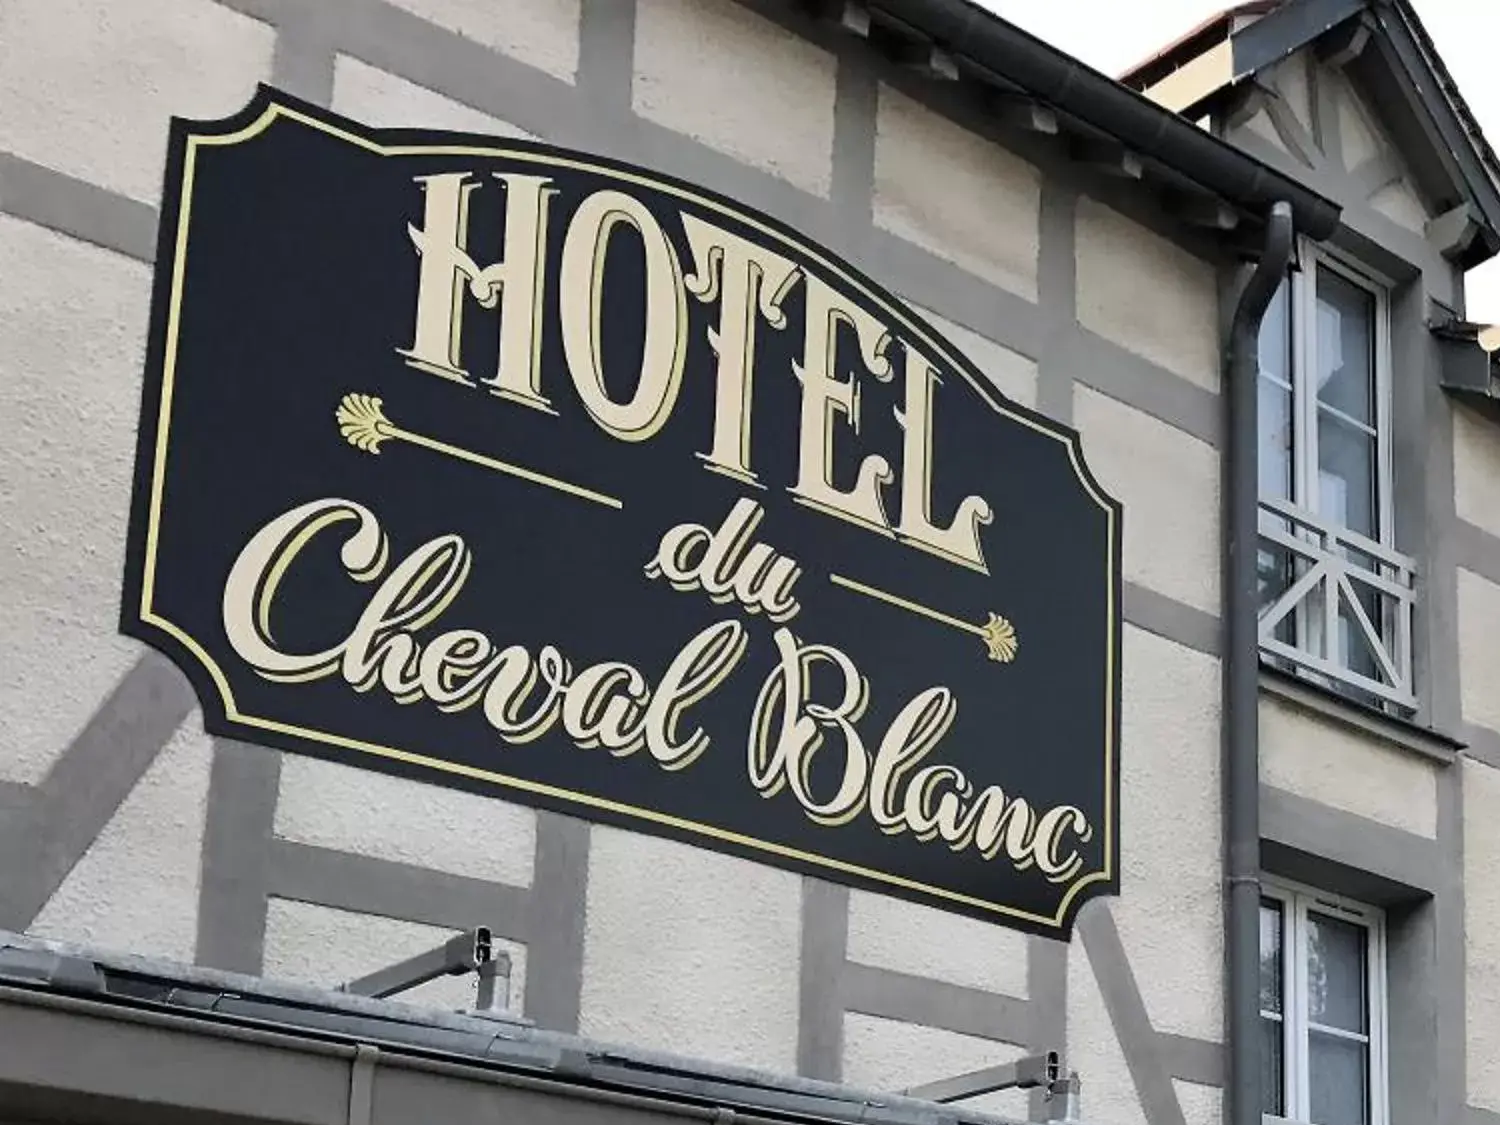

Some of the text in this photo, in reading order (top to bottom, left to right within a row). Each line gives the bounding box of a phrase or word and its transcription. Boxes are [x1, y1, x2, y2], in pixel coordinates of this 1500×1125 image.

[395, 170, 992, 576] HOTEL
[645, 498, 802, 621] du
[222, 496, 1094, 882] Cheval Blanc
